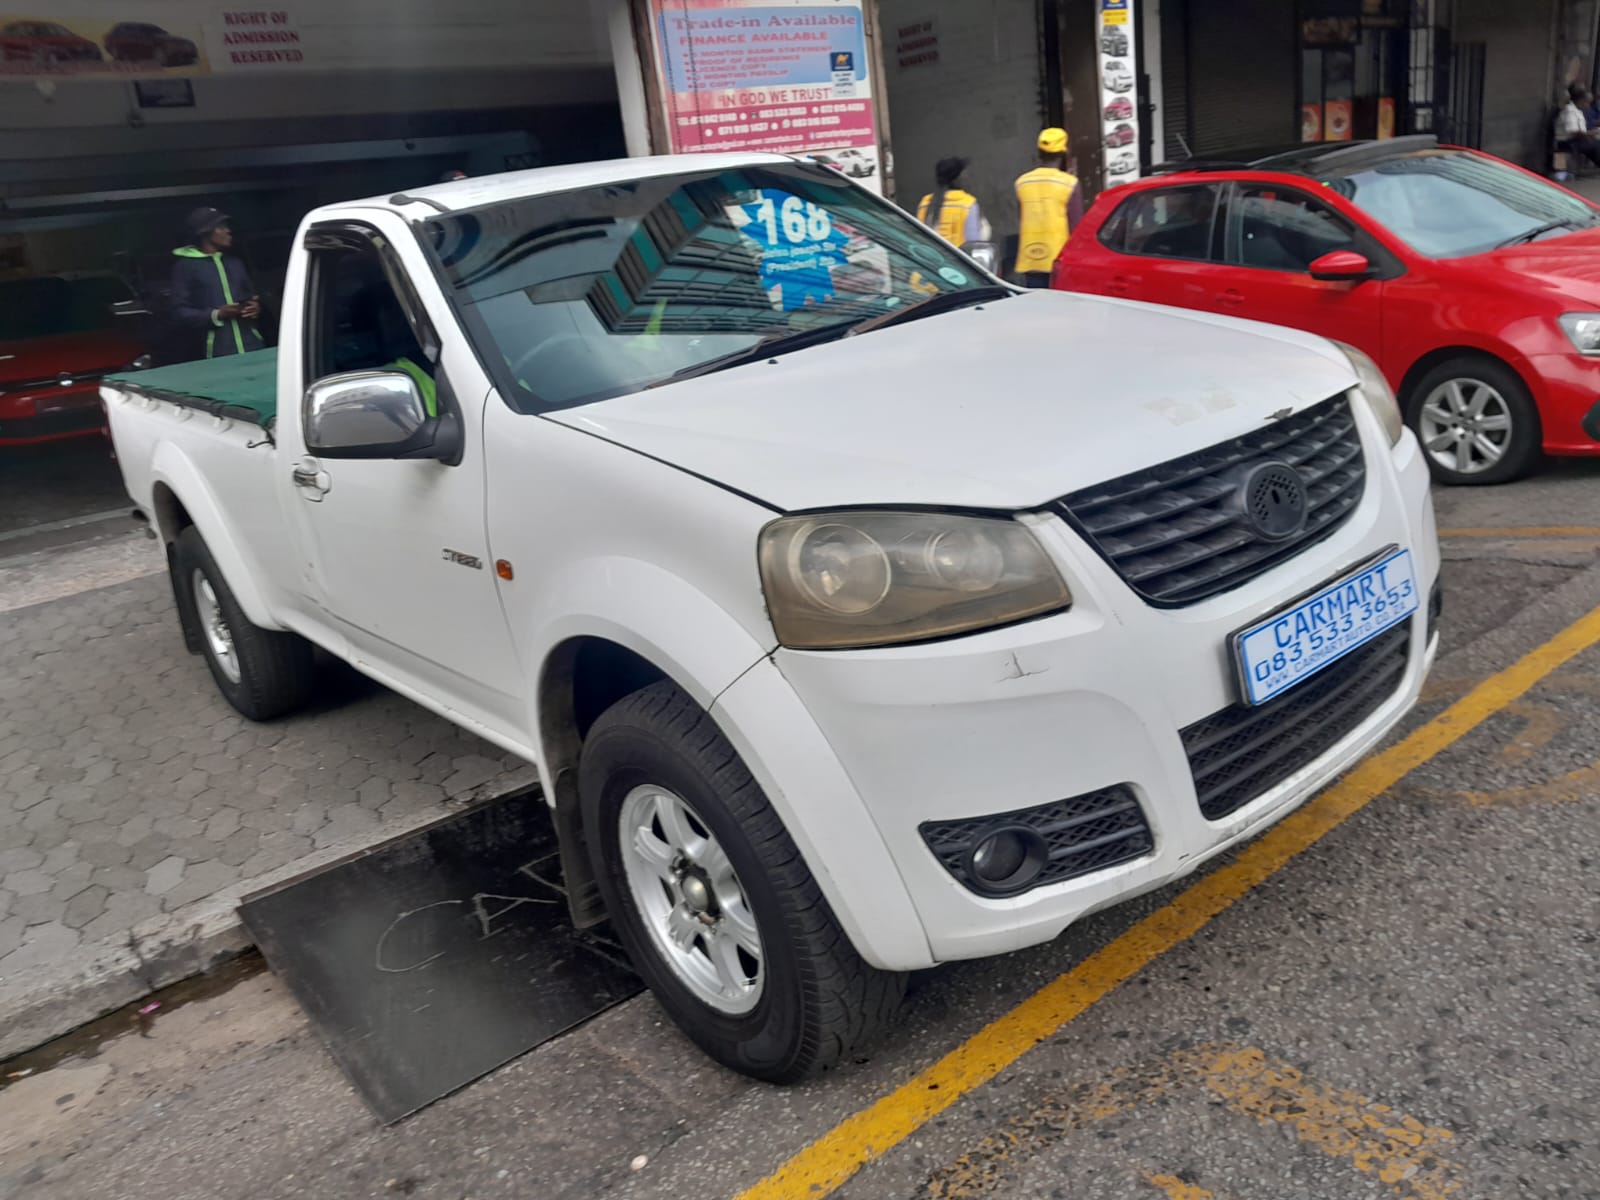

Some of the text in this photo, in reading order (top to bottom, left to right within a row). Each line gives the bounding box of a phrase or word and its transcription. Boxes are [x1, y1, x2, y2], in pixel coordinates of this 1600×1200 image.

[224, 12, 288, 24] RIGHT OF
[673, 14, 856, 31] Trade-in Available
[224, 31, 299, 44] ADMISSION
[679, 31, 828, 46] FINANCE AVAILABLE
[231, 50, 304, 64] RESERVED
[740, 92, 766, 105] GOD
[769, 89, 787, 102] WE
[1274, 565, 1388, 648] CARMART
[1254, 579, 1412, 682] 083 533 3653
